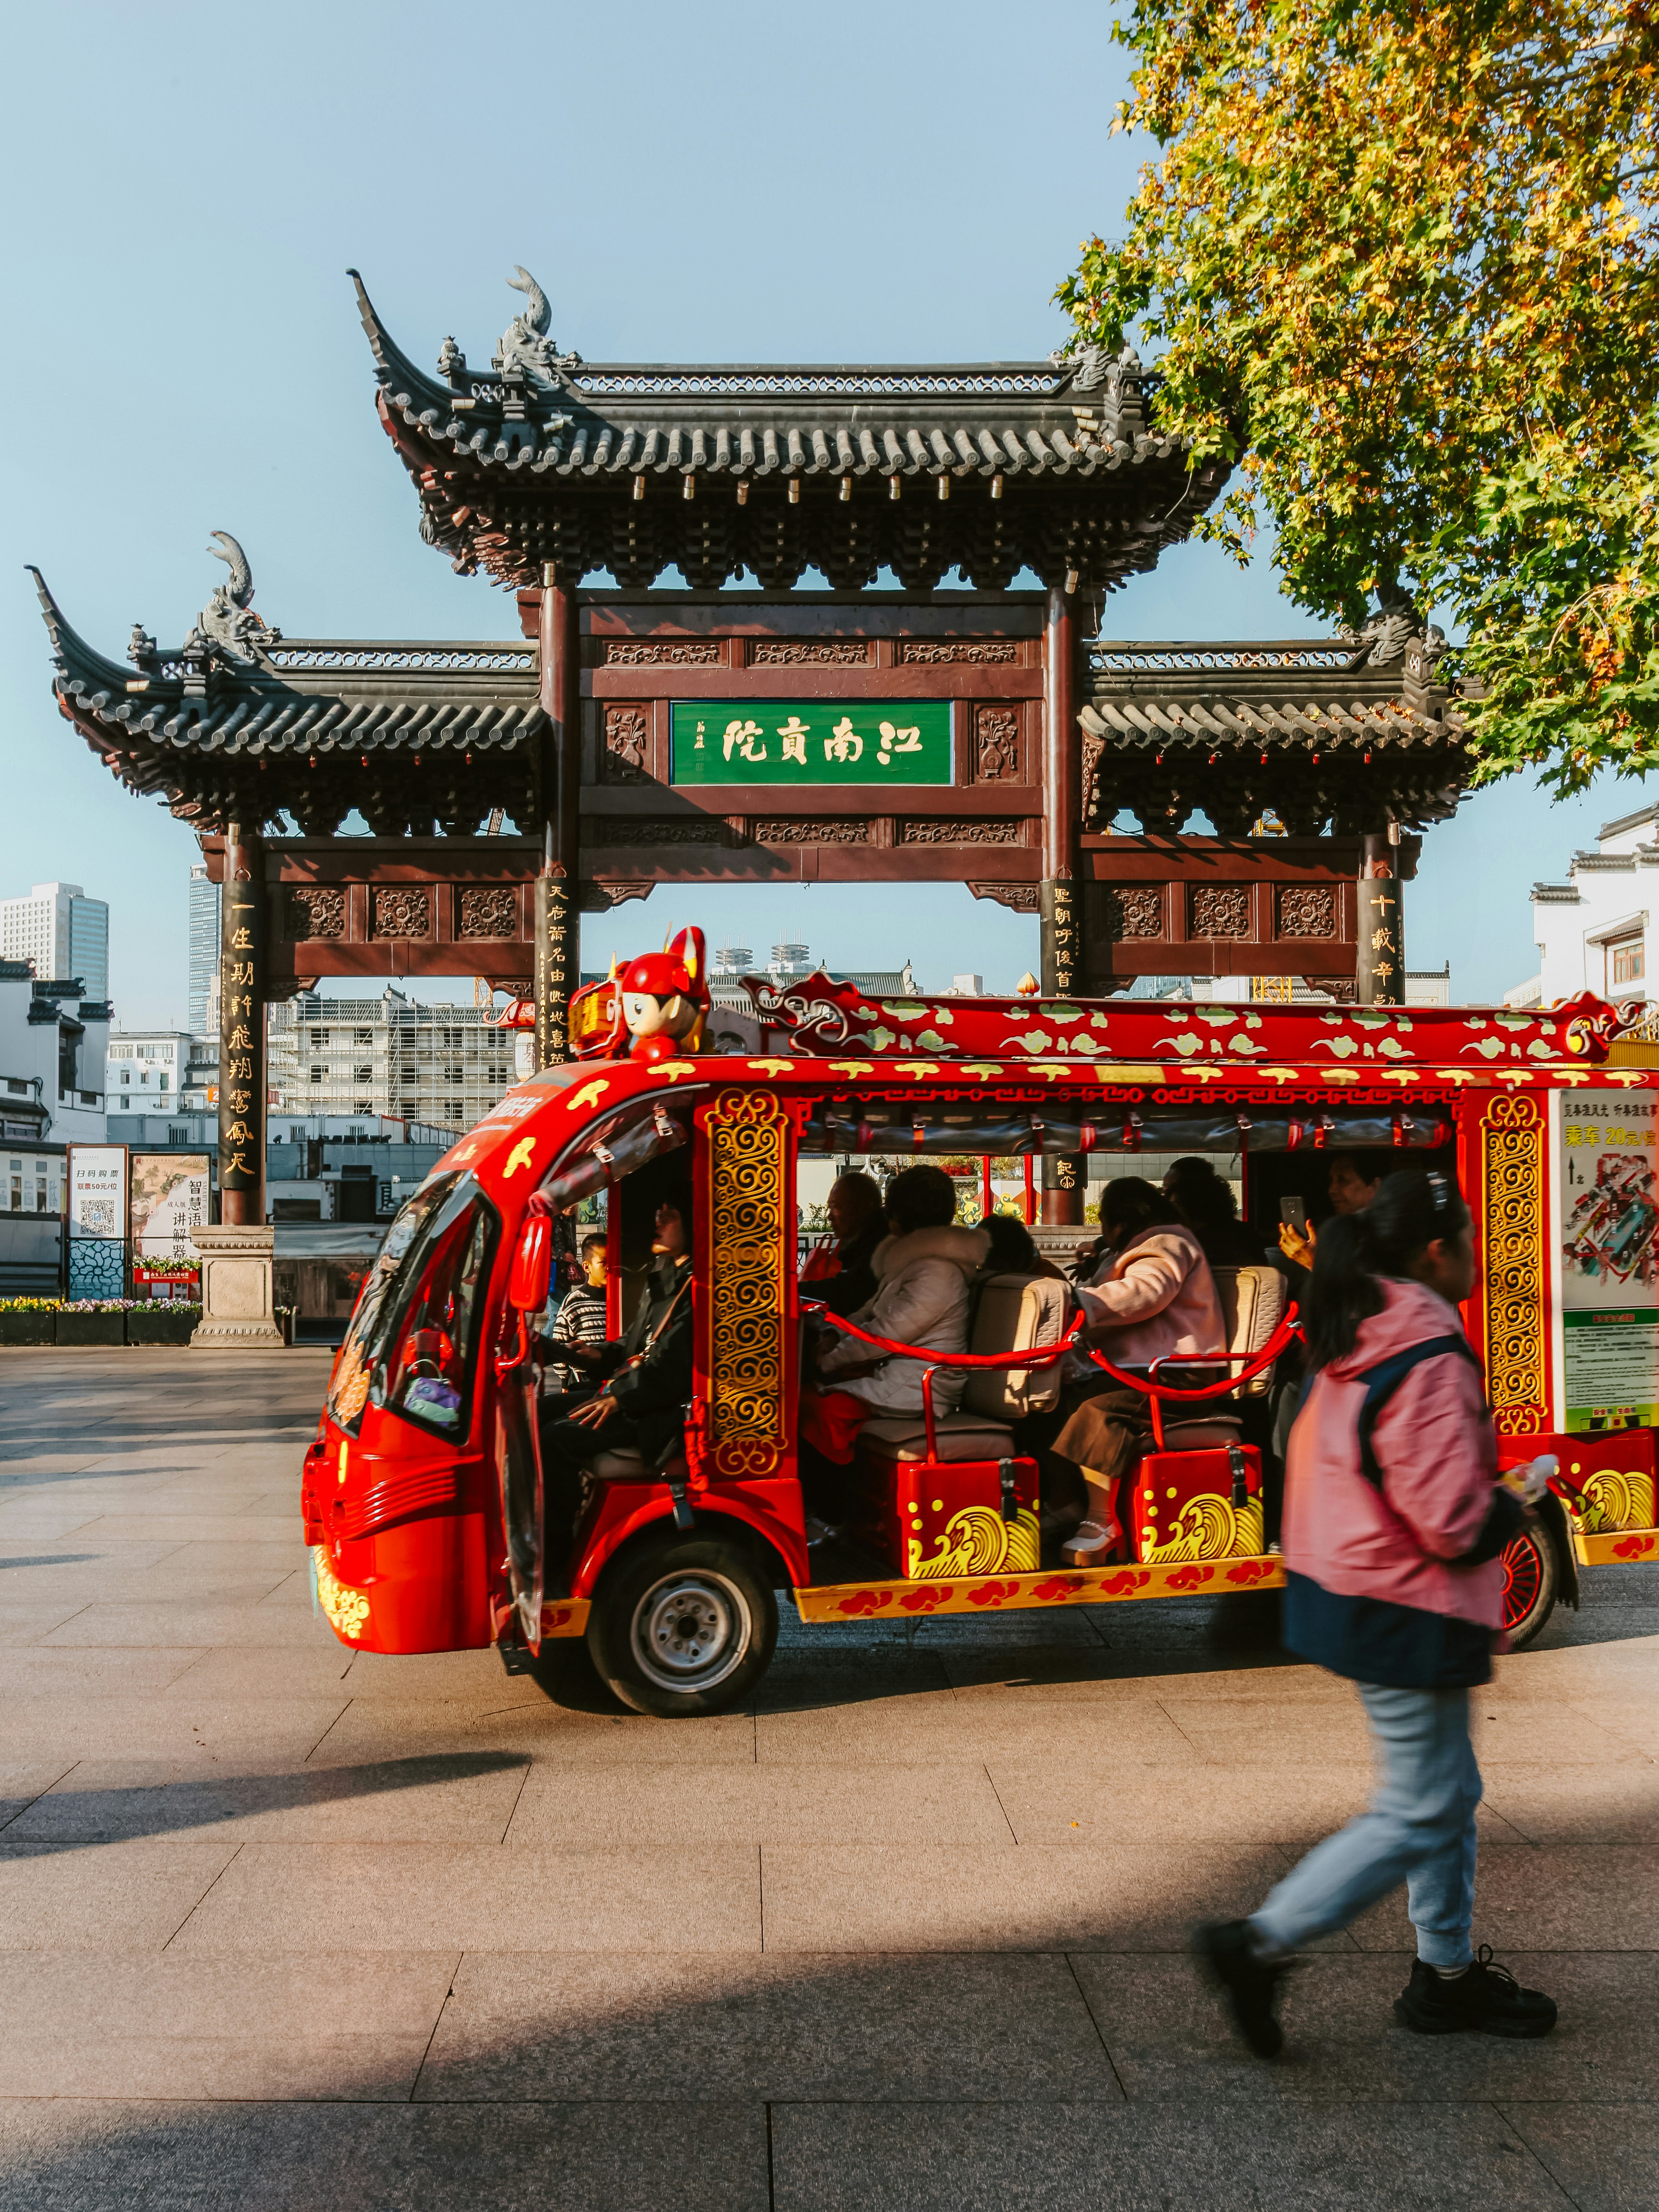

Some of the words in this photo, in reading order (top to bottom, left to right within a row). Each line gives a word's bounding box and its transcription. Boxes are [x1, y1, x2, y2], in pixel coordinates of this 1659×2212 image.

[723, 716, 922, 765] 江南貢院
[1054, 888, 1074, 998] 聖朝吁俊首
[1564, 1125, 1600, 1148] 乘车
[76, 1169, 119, 1178] 扫码购票
[77, 1182, 118, 1191] 联票50元/位
[187, 1180, 201, 1236] 智慧语
